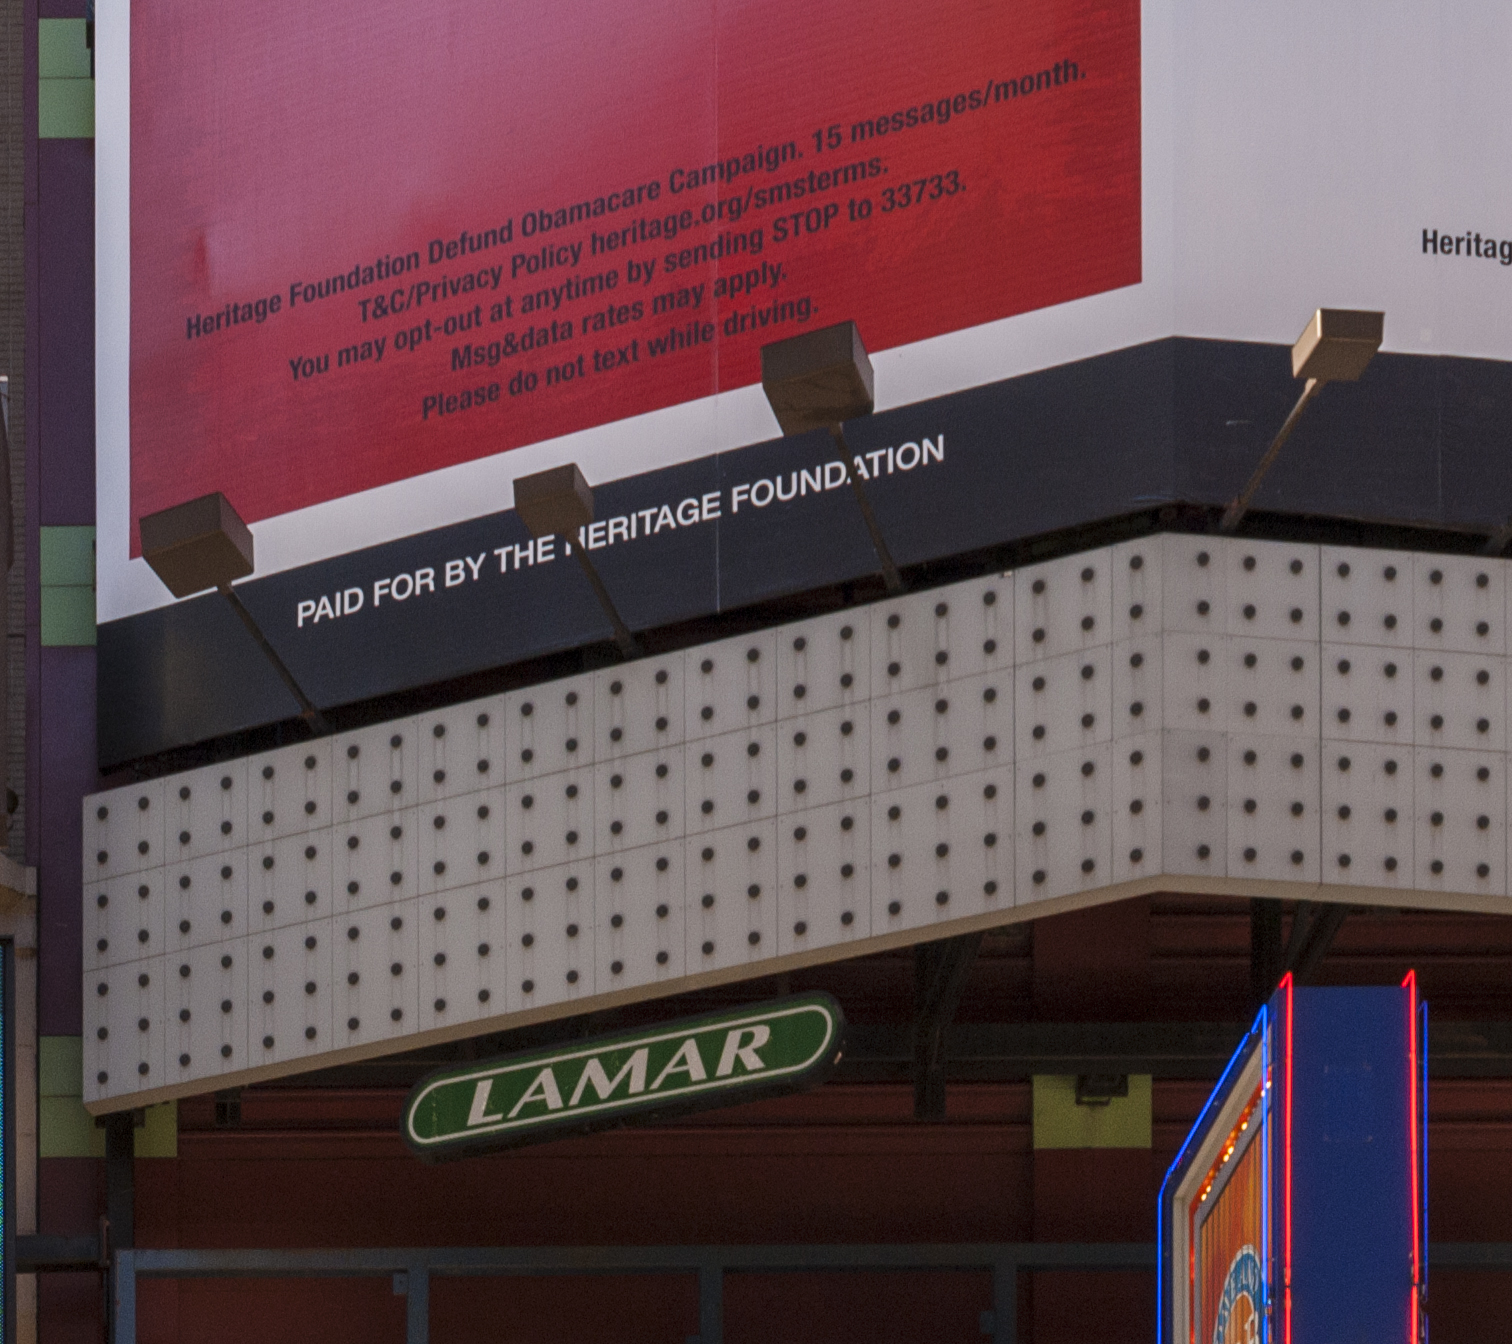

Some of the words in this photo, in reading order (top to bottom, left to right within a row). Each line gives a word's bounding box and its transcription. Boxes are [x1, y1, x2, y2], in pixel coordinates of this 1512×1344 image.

[185, 290, 282, 341] Heritage
[288, 248, 420, 308] Foundation
[427, 218, 514, 266] Defund
[520, 180, 663, 240] Obamacare
[668, 140, 805, 196] Campaign.
[812, 123, 843, 154] 15
[850, 57, 1087, 144] messages/month.
[288, 352, 330, 382] You
[337, 337, 387, 369] may
[393, 306, 483, 354] opt-out
[489, 295, 514, 322] at
[520, 265, 621, 315] anytime
[626, 257, 658, 286] by
[663, 224, 764, 274] sending
[772, 202, 840, 244] STOP
[847, 196, 873, 222] to
[880, 168, 967, 214] 33733.
[357, 264, 503, 326] T&C/Privacy
[510, 235, 583, 280] Policy
[590, 155, 889, 256] heritage.org/smsterms.
[421, 380, 501, 421] Please
[508, 368, 539, 396] do
[545, 355, 586, 387] not
[592, 340, 640, 374] text
[647, 322, 716, 358] while
[723, 295, 820, 338] driving.
[451, 320, 574, 372] Msg&data
[581, 297, 645, 335] rates
[652, 282, 706, 316] may
[713, 257, 788, 299] apply.
[294, 587, 365, 630] PAID
[372, 569, 437, 610] FOR
[443, 555, 488, 594] BY
[493, 534, 556, 576] THE
[564, 491, 722, 557] HERITAGE
[730, 434, 946, 517] FOUNDATION
[464, 1021, 774, 1128] LAMAR
